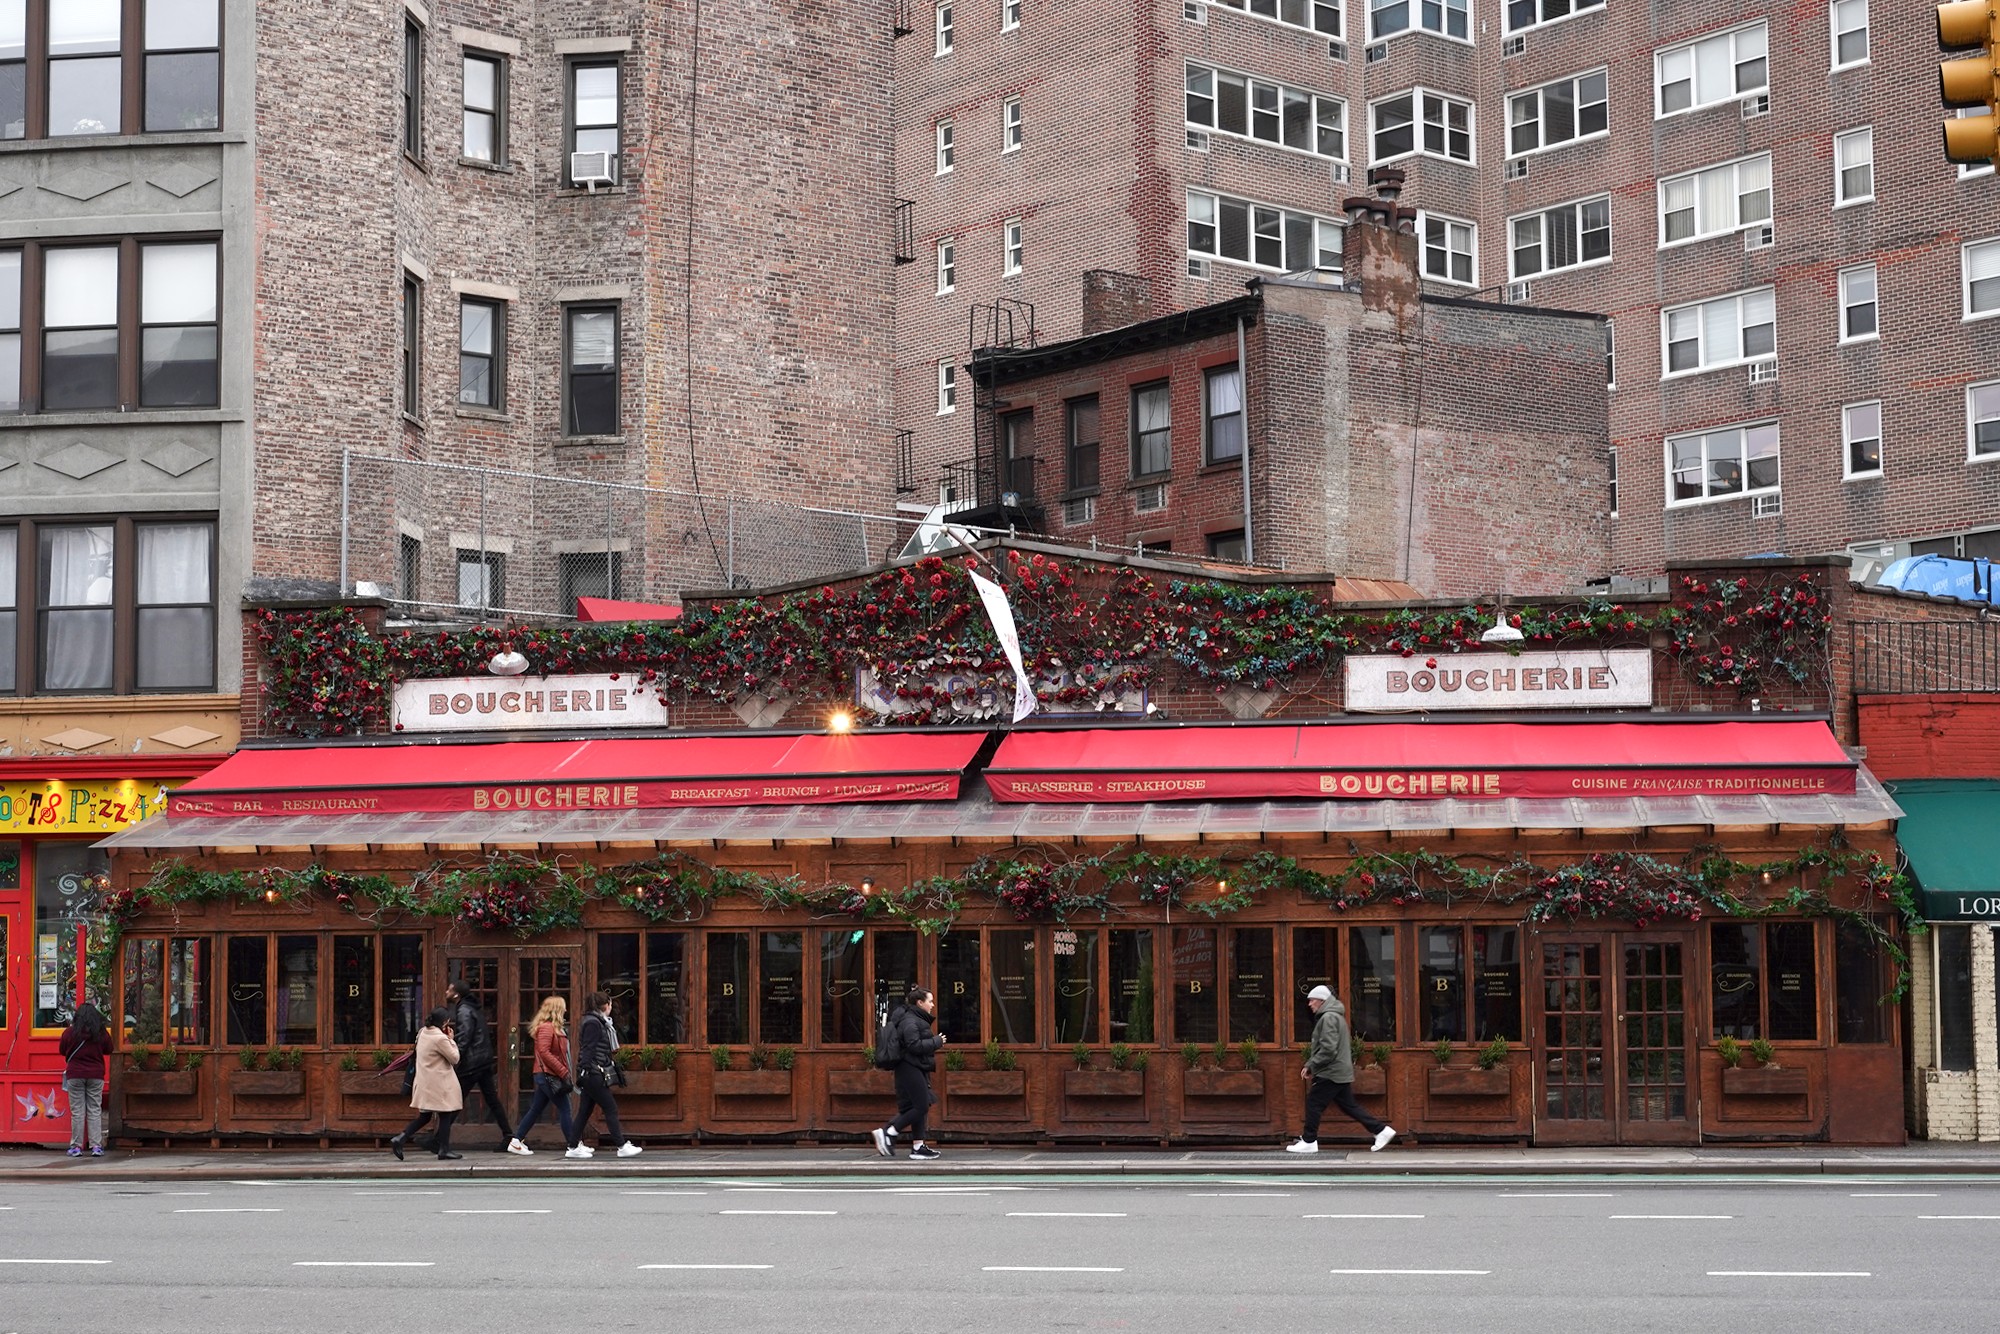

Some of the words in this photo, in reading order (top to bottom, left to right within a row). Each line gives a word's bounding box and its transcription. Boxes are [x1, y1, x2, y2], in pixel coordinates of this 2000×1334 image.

[1386, 667, 1609, 693] BOUCHERIE
[428, 689, 627, 715] BOUCHERIE
[670, 788, 751, 800] BREAKFAST
[762, 786, 820, 797] BRUNCH
[834, 784, 882, 796] LUNCH
[1011, 781, 1093, 793] BRASSERIE
[1106, 780, 1206, 793] STEAKHOUSE
[1319, 774, 1500, 795] BOUCHERIE
[1572, 778, 1628, 789] CUISINE
[1633, 778, 1703, 791] FRANÇAISE
[1706, 778, 1825, 789] TRADITIONNELLE
[233, 801, 264, 812] BAR
[282, 798, 378, 811] RESTAURANT
[473, 785, 639, 809] BOUCHERIE
[1959, 897, 2000, 915] LOR
